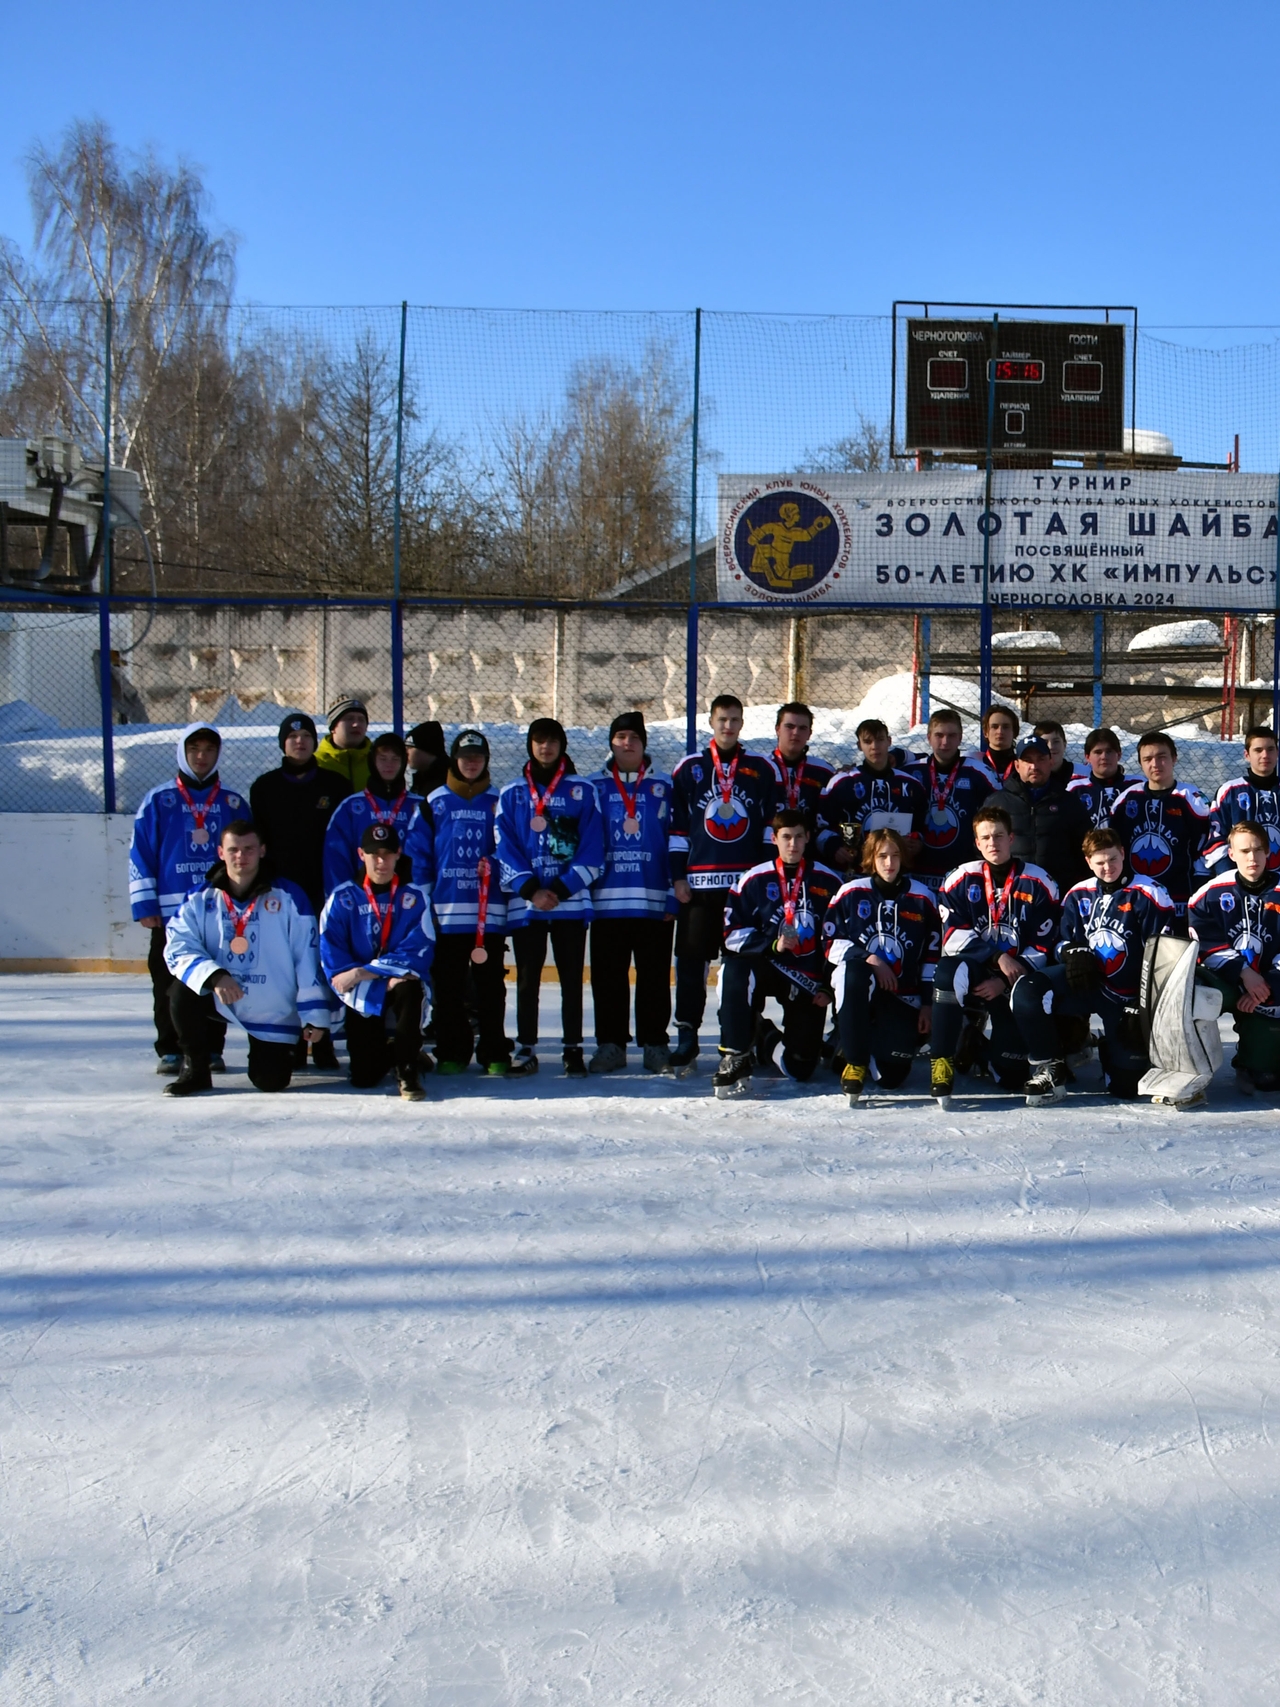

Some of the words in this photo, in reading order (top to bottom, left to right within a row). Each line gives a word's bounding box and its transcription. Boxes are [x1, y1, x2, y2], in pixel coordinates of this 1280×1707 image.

[912, 330, 984, 342] ЧЕРНОГОЛОВКА
[1068, 334, 1098, 345] ГОСТИ
[938, 350, 958, 358] СЧЕТ
[1001, 351, 1031, 359] ТАЙМЕР
[1073, 353, 1093, 361] СЧЕТ
[930, 391, 970, 400] УДАЛЕНИЯ
[1060, 394, 1100, 402] УДАЛЕНИЯ
[1000, 402, 1031, 411] ПЕРИОД
[1032, 476, 1132, 490] ТУРНИР
[765, 480, 794, 491] КЛУБ
[799, 481, 832, 502] ЮНЫХ
[1114, 497, 1160, 507] ЮНЫХ
[875, 512, 1099, 537] ЗОЛОТАЯ
[1014, 543, 1145, 557] ПОСВЯЩЁННЫЙ
[876, 563, 1035, 584] 50-ЛЕТИЮ
[1049, 563, 1088, 583] ХК
[990, 593, 1128, 605] ЧЕРНОГОЛОВКА
[1133, 592, 1175, 605] 2024
[614, 862, 641, 873] ОКРУГА
[928, 931, 940, 951] 2
